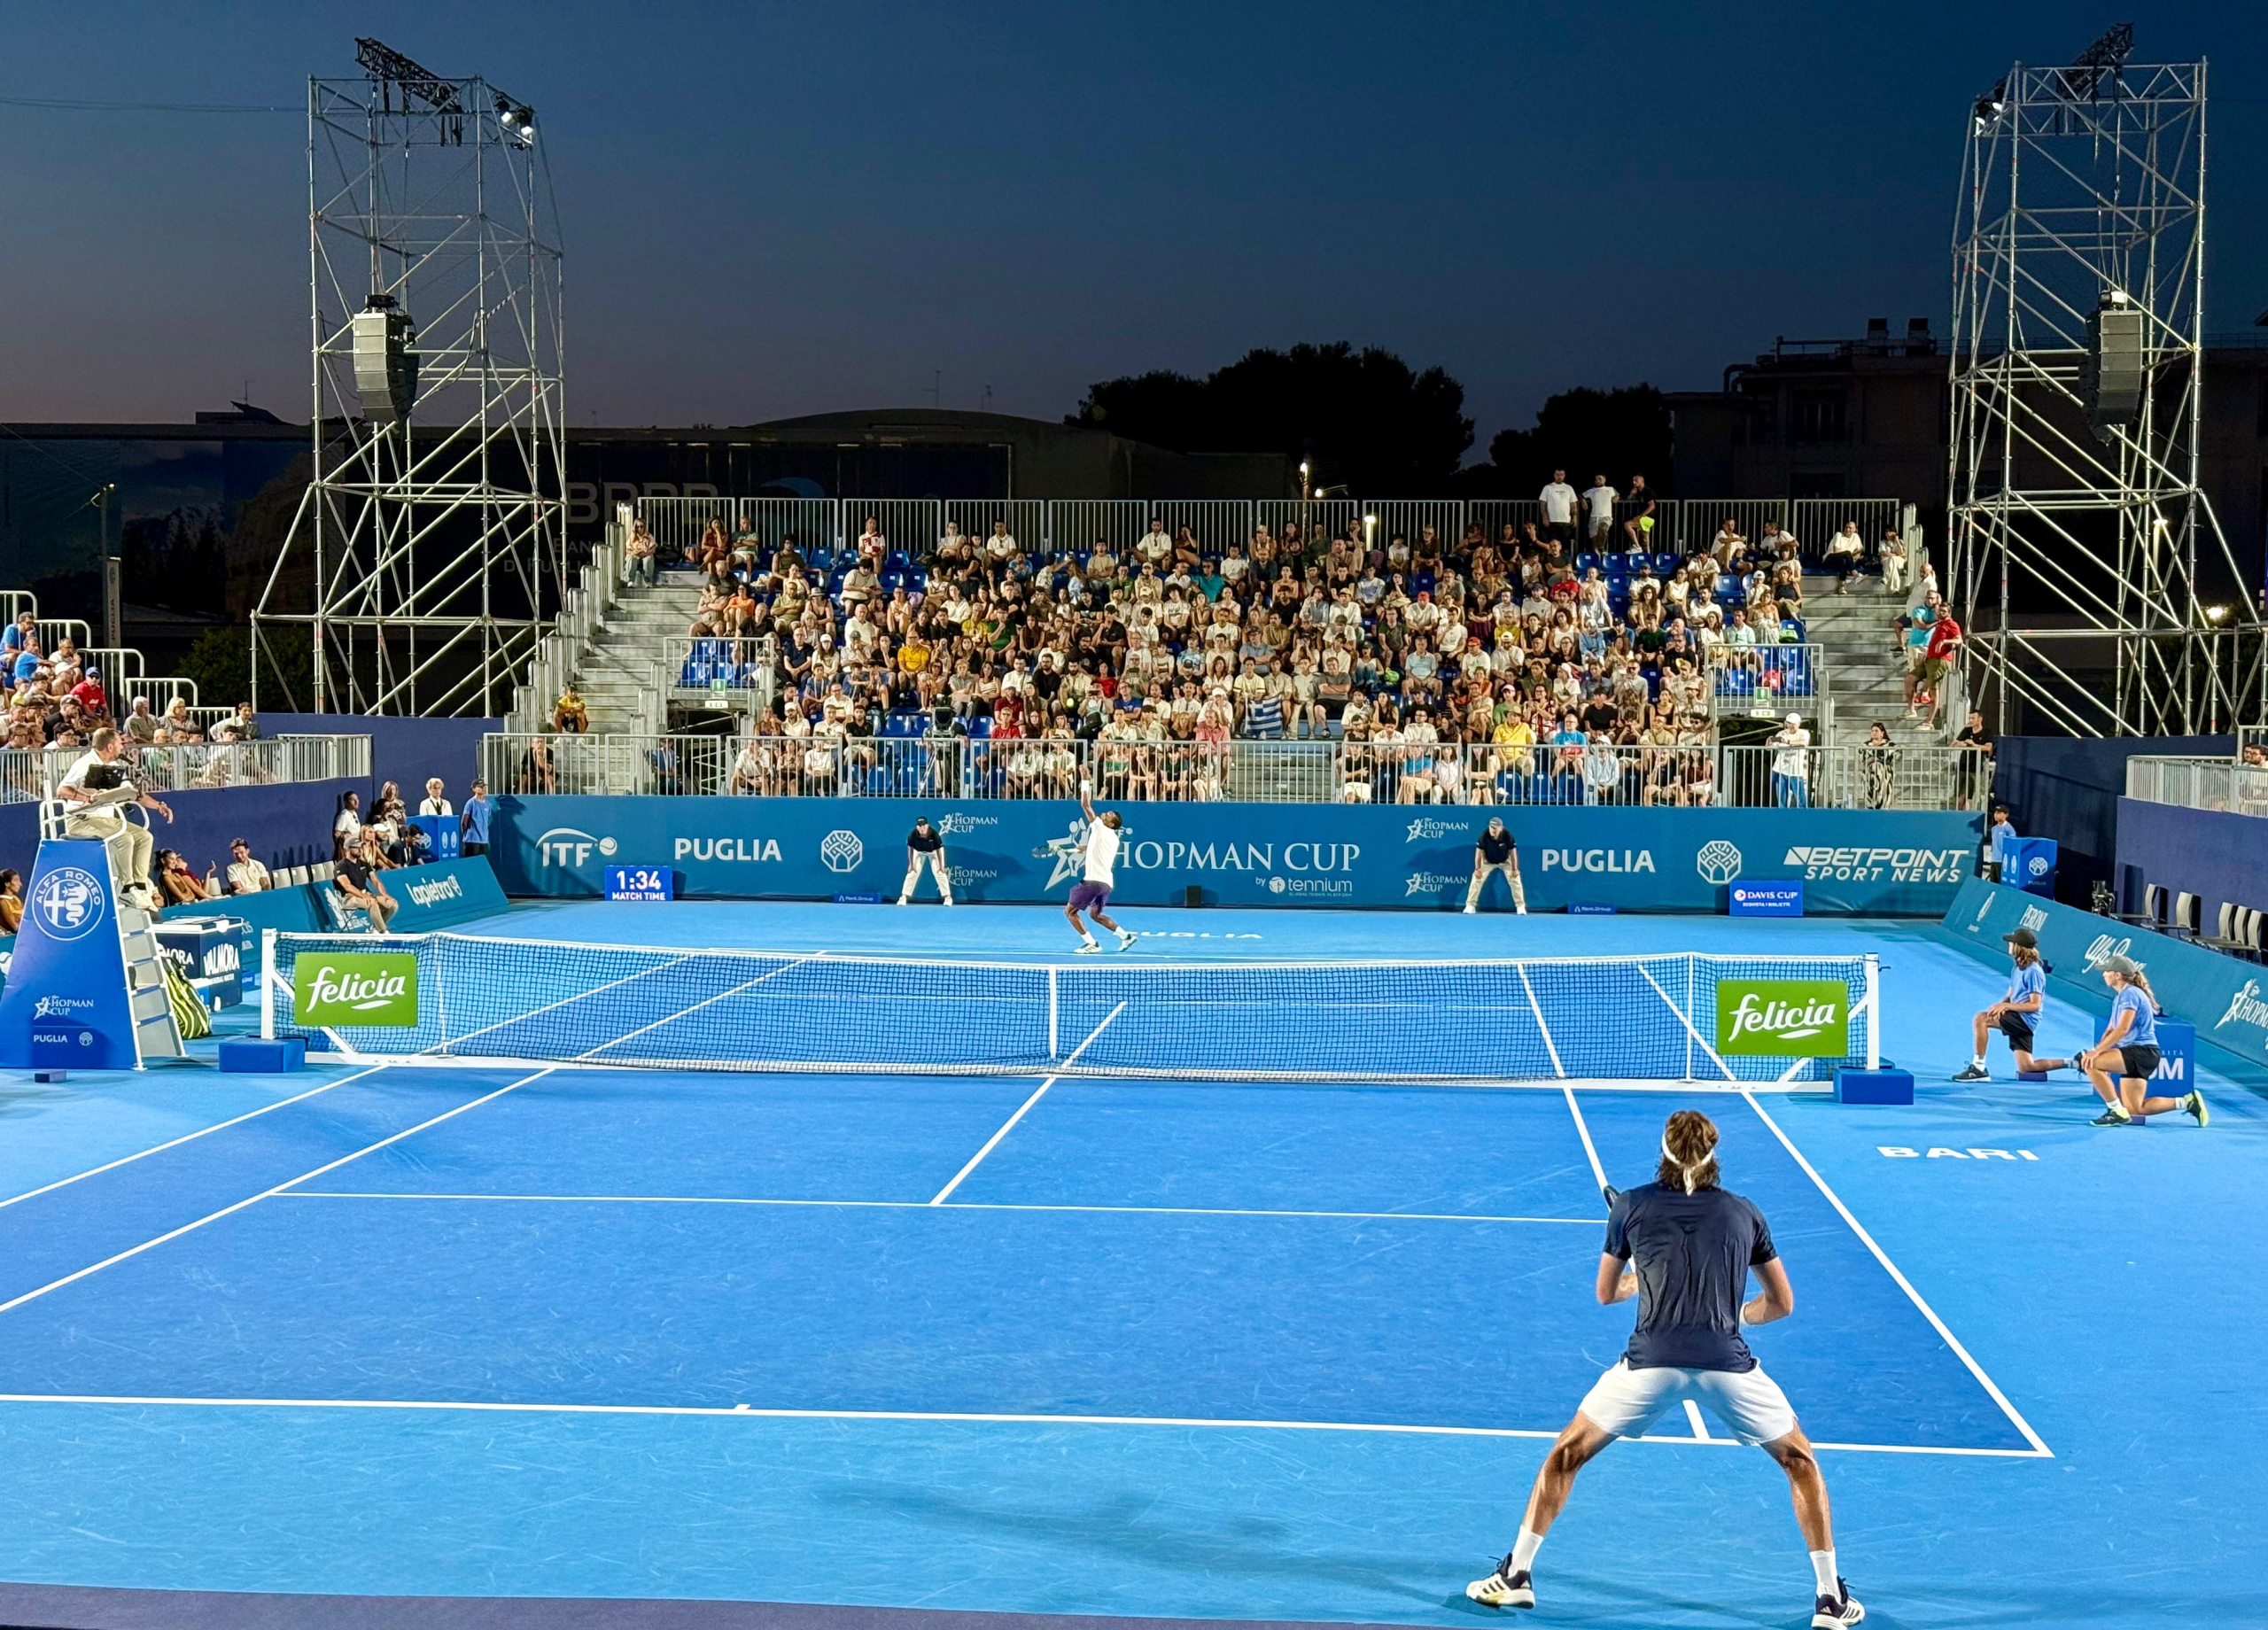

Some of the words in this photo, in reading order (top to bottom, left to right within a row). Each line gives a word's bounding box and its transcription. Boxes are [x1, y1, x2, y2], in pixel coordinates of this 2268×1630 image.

[954, 816, 998, 825] HOPMAN
[1424, 821, 1469, 831] HOPMAN
[954, 825, 975, 834] CUP
[1424, 830, 1445, 839] CUP
[542, 842, 593, 868] ITF
[674, 837, 783, 862] PUGLIA
[1284, 842, 1361, 872] CUP
[1542, 849, 1656, 873] PUGLIA
[1806, 846, 1970, 869] BETPOINT
[616, 870, 662, 890] 1:34
[953, 869, 998, 878] HOPMAN
[1423, 875, 1468, 884] HOPMAN
[1804, 865, 1884, 881] SPORT
[1891, 867, 1962, 883] NEWS
[35, 874, 60, 905] ALFA
[65, 870, 102, 906] ROMEO
[953, 877, 974, 887] CUP
[1254, 875, 1266, 887] by
[1287, 877, 1353, 892] tennium
[1422, 883, 1443, 893] CUP
[611, 891, 643, 901] MATCH
[644, 891, 666, 901] TIME
[1747, 890, 1775, 900] DAVIS
[1776, 890, 1798, 900] CUP
[203, 943, 240, 976] VALMORA
[306, 966, 407, 1014] felicia
[50, 998, 95, 1008] HOPMAN
[50, 1007, 71, 1016] CUP
[1728, 993, 1836, 1043] felicia
[33, 1034, 68, 1044] PUGLIA
[1876, 1145, 2040, 1161] BARI
